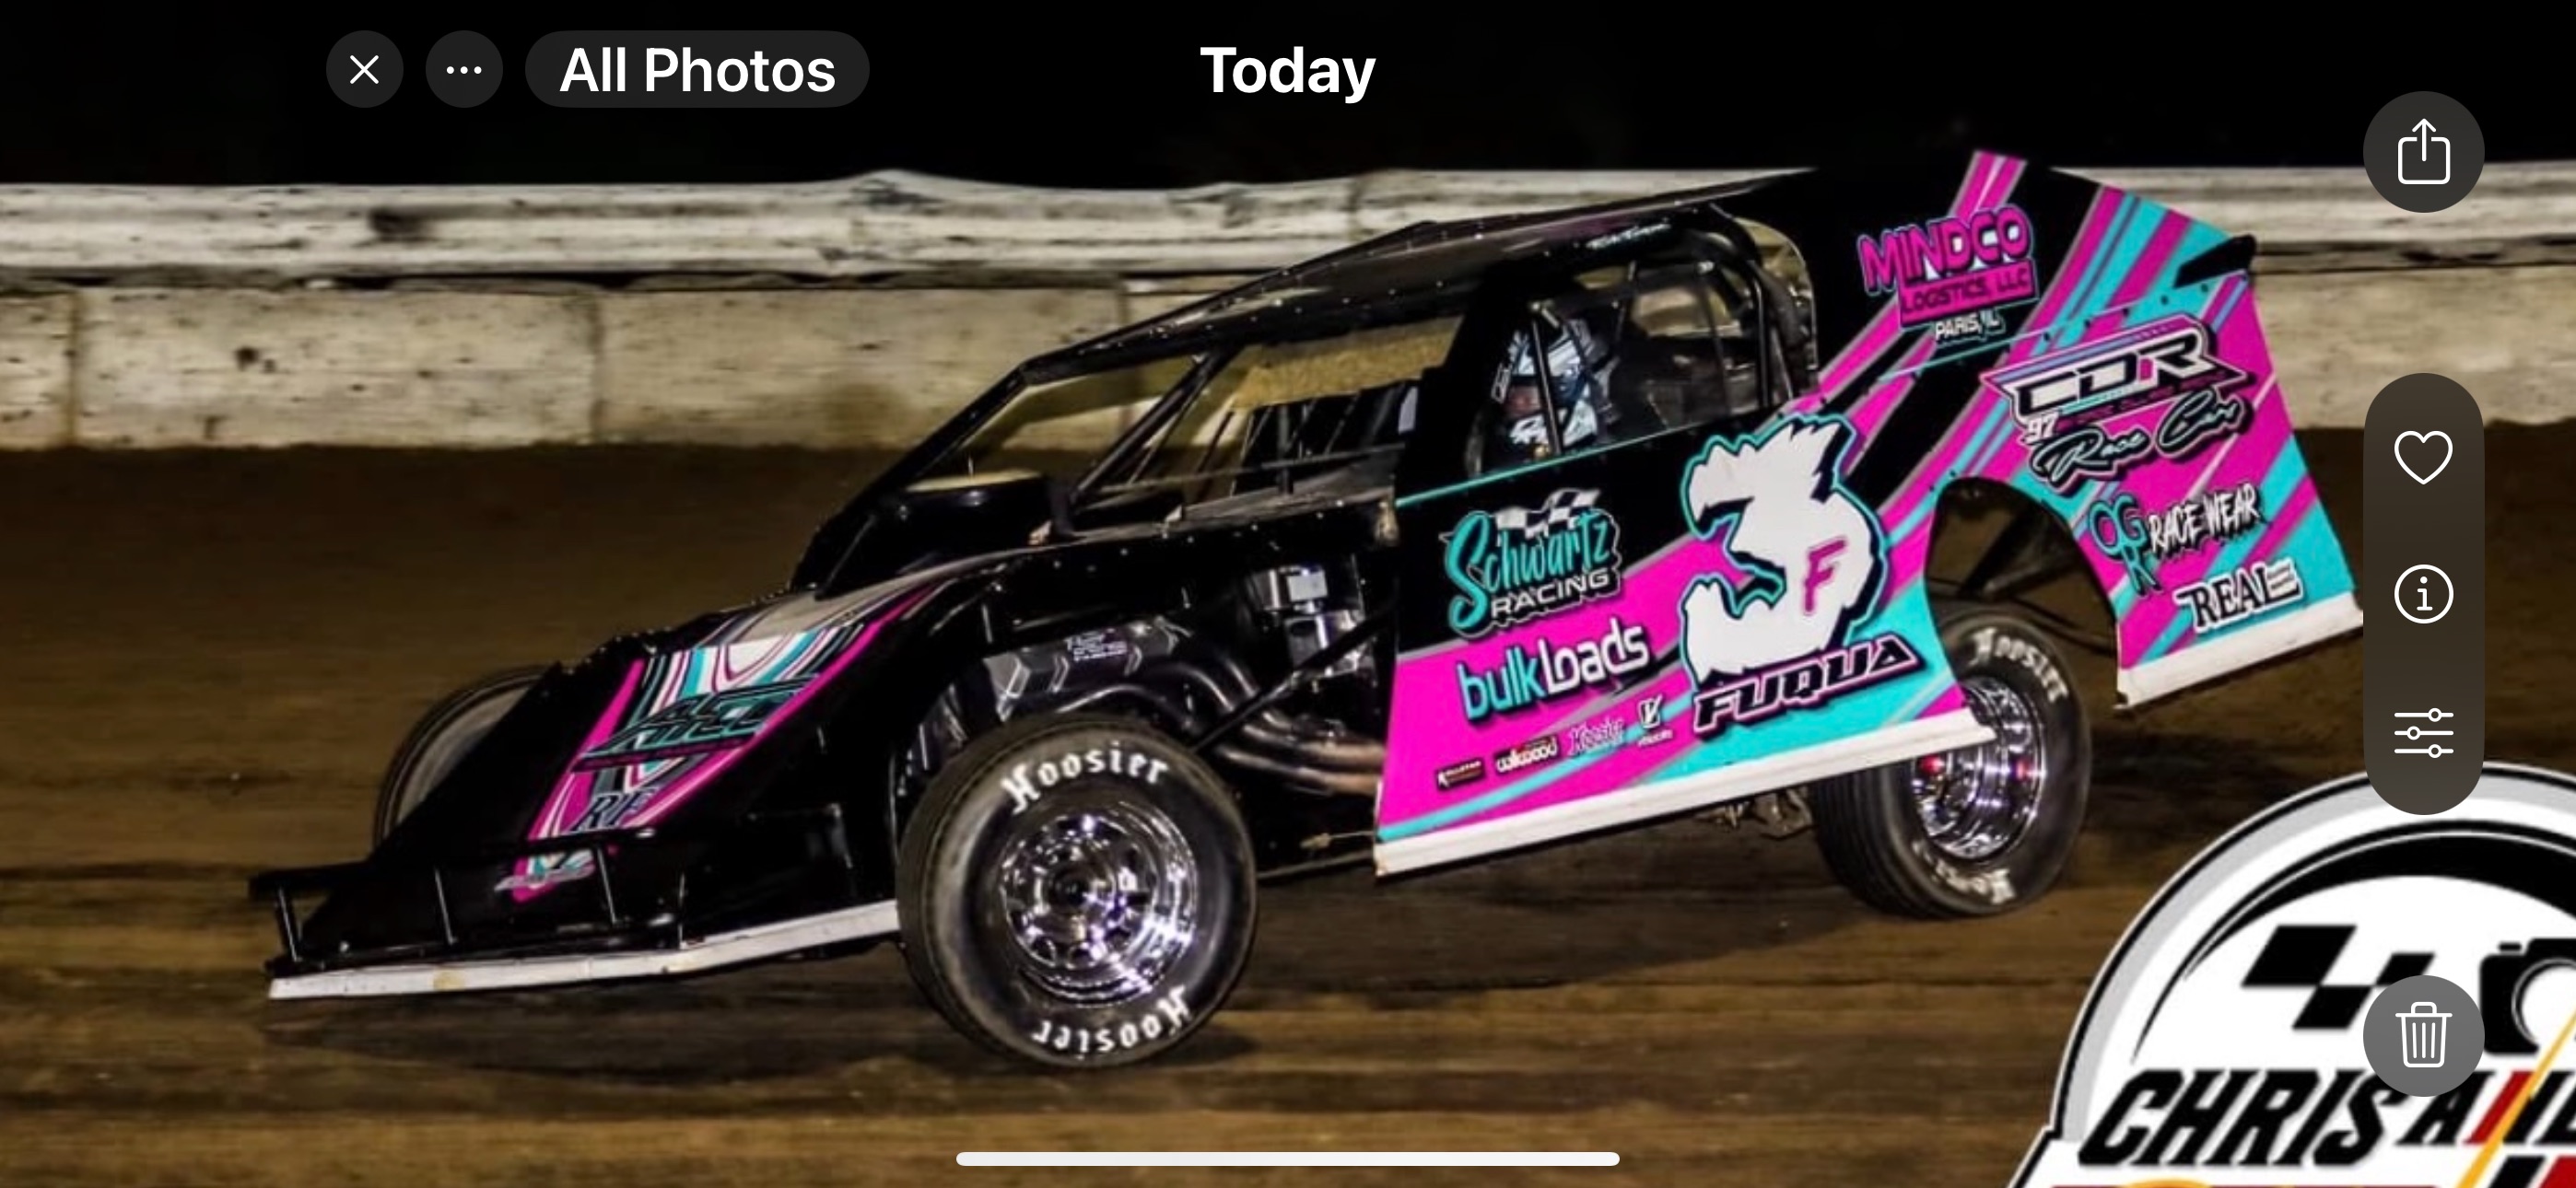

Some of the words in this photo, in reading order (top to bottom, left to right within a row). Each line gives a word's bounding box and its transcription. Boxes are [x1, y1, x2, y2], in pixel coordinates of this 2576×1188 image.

[1858, 204, 2031, 291] MINDCO
[2024, 412, 2059, 444] 97
[1688, 419, 1876, 685] 3
[2149, 503, 2202, 553] RACE
[2203, 483, 2260, 536] WEAR
[1446, 509, 1610, 629] Schwartz
[1492, 568, 1610, 618] RACING
[1804, 537, 1847, 614] F
[1694, 636, 1916, 730] FUQUA
[1001, 740, 1170, 815] Hoosier
[1032, 984, 1193, 1061] Hoosier
